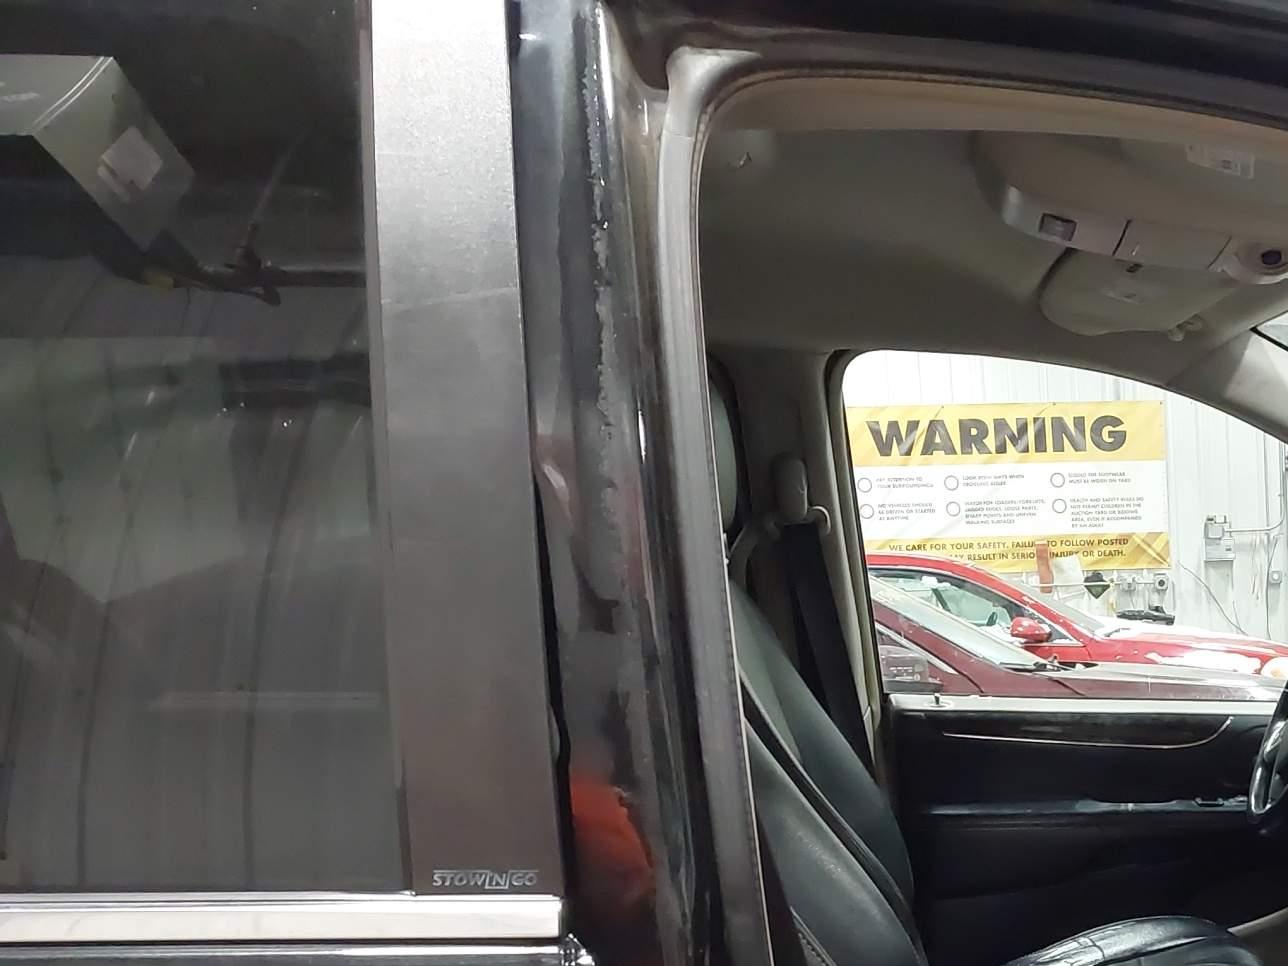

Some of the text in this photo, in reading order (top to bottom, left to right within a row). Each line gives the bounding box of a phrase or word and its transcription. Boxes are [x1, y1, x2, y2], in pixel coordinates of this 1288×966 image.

[866, 415, 1127, 457] WARNING
[889, 544, 905, 552] WE
[905, 544, 927, 552] CARE
[930, 543, 947, 551] FOR
[951, 542, 974, 550] YOUR
[1011, 540, 1036, 548] FAILU
[1060, 539, 1095, 547] FOLLOW
[1097, 538, 1129, 546] POSTED
[967, 552, 996, 561] RESULT
[998, 552, 1009, 560] IN
[1011, 551, 1036, 560] SERIO
[1082, 550, 1095, 558] OR
[1097, 549, 1126, 557] DEATH.
